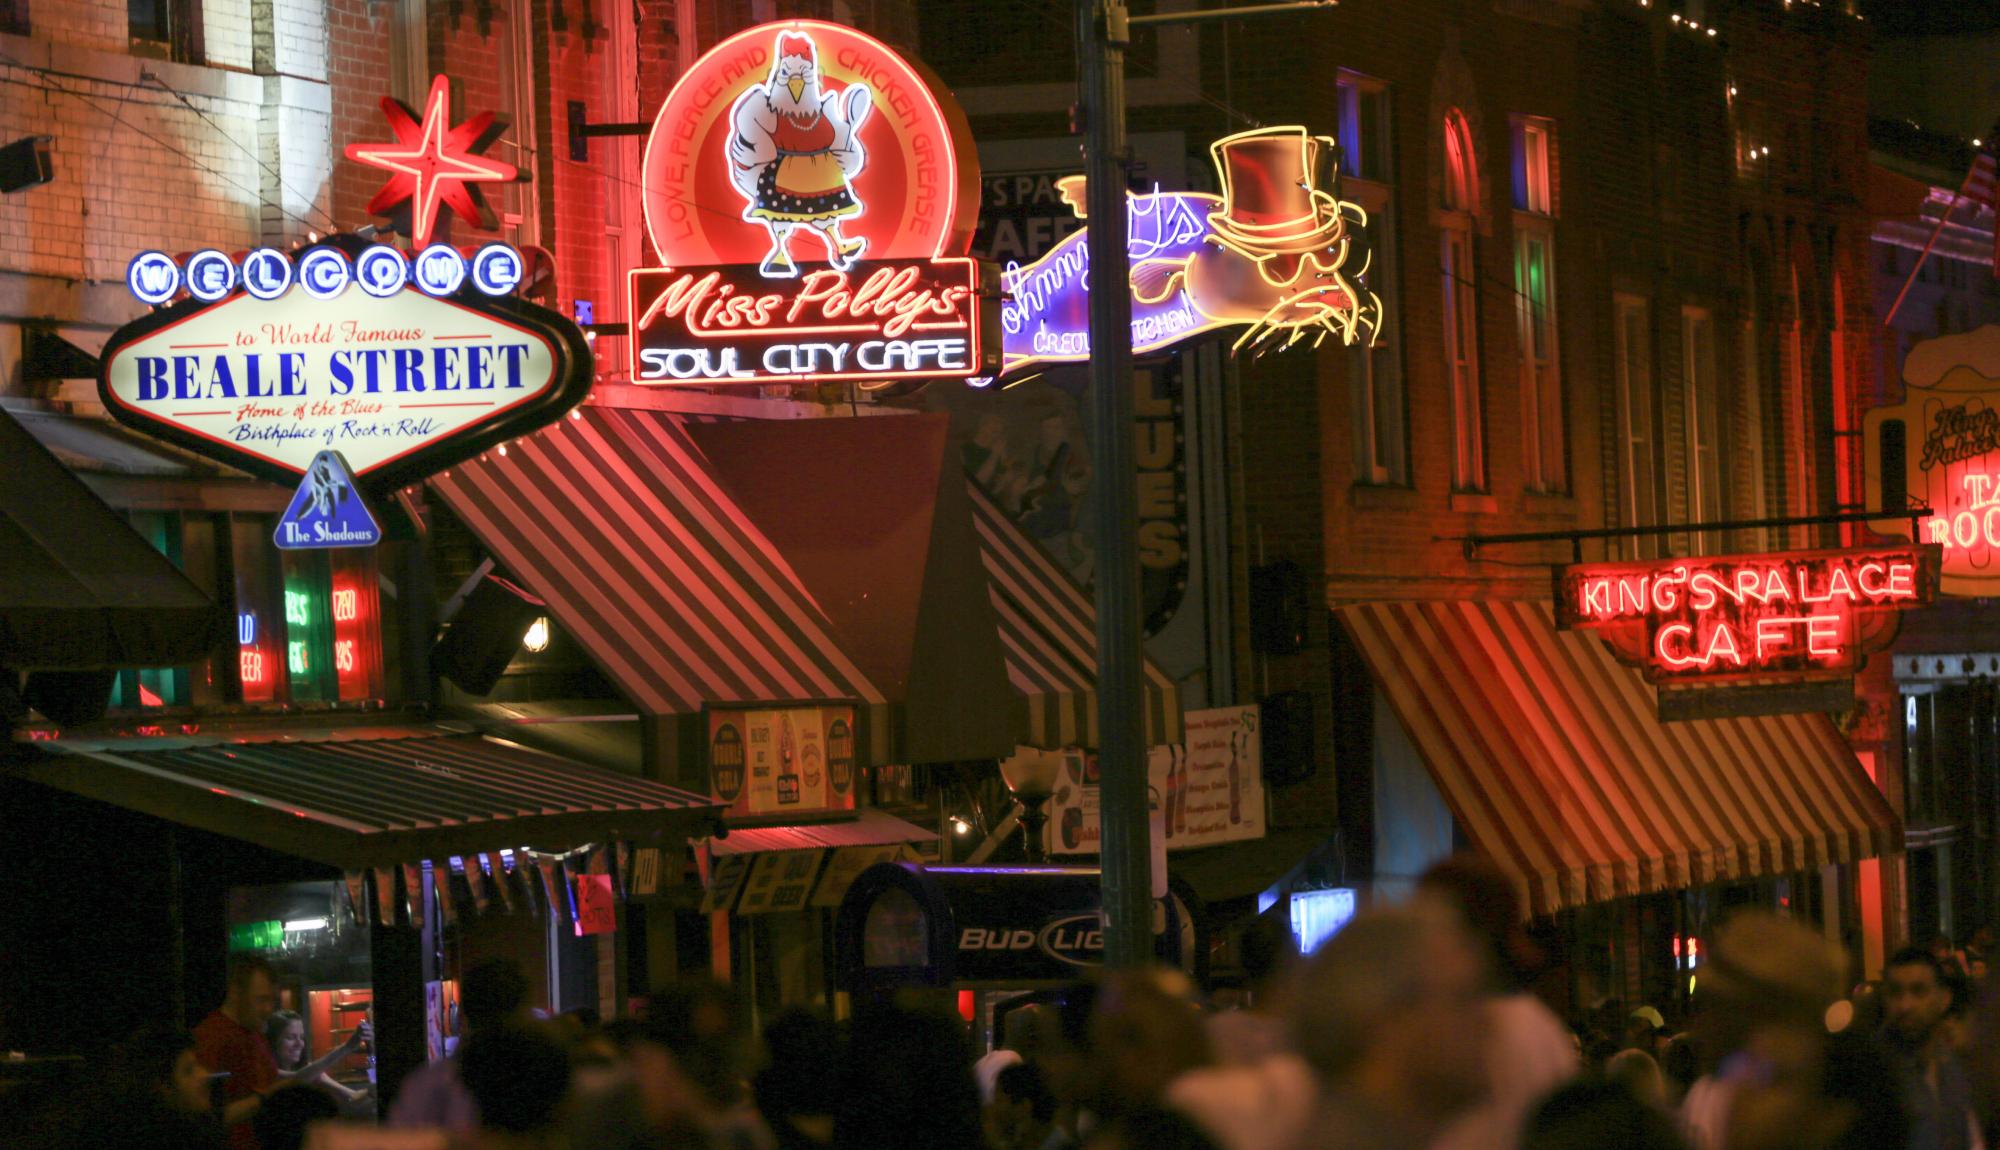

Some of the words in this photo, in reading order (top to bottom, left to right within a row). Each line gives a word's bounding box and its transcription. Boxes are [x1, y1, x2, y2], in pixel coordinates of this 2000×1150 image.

[722, 47, 767, 84] AND
[837, 47, 922, 129] CHICKEN
[671, 78, 723, 158] PEACE
[664, 163, 694, 242] LOVE,
[910, 134, 938, 237] GREASE
[137, 251, 517, 296] WELCOME
[639, 271, 783, 331] Miss
[236, 330, 256, 346] to
[261, 323, 334, 346] World
[340, 321, 425, 342] Famous
[135, 352, 307, 400] BEALE
[329, 344, 529, 395] STREET
[640, 348, 756, 378] SOUL
[763, 342, 851, 374] CITY
[857, 338, 967, 371] CAFE
[236, 402, 286, 421] Home
[293, 402, 307, 419] of
[311, 401, 334, 416] the
[340, 398, 383, 415] Blues
[229, 422, 317, 447] Birthplace
[322, 427, 335, 445] of
[1134, 368, 1183, 568] LUES
[284, 521, 310, 543] The
[313, 520, 372, 542] Shadows
[1583, 566, 1716, 613] KING'S
[1736, 564, 1913, 603] PALACE
[1659, 615, 1841, 664] CAFE
[240, 651, 262, 682] EER
[957, 928, 1037, 950] BUD
[1053, 928, 1105, 950] LIG
